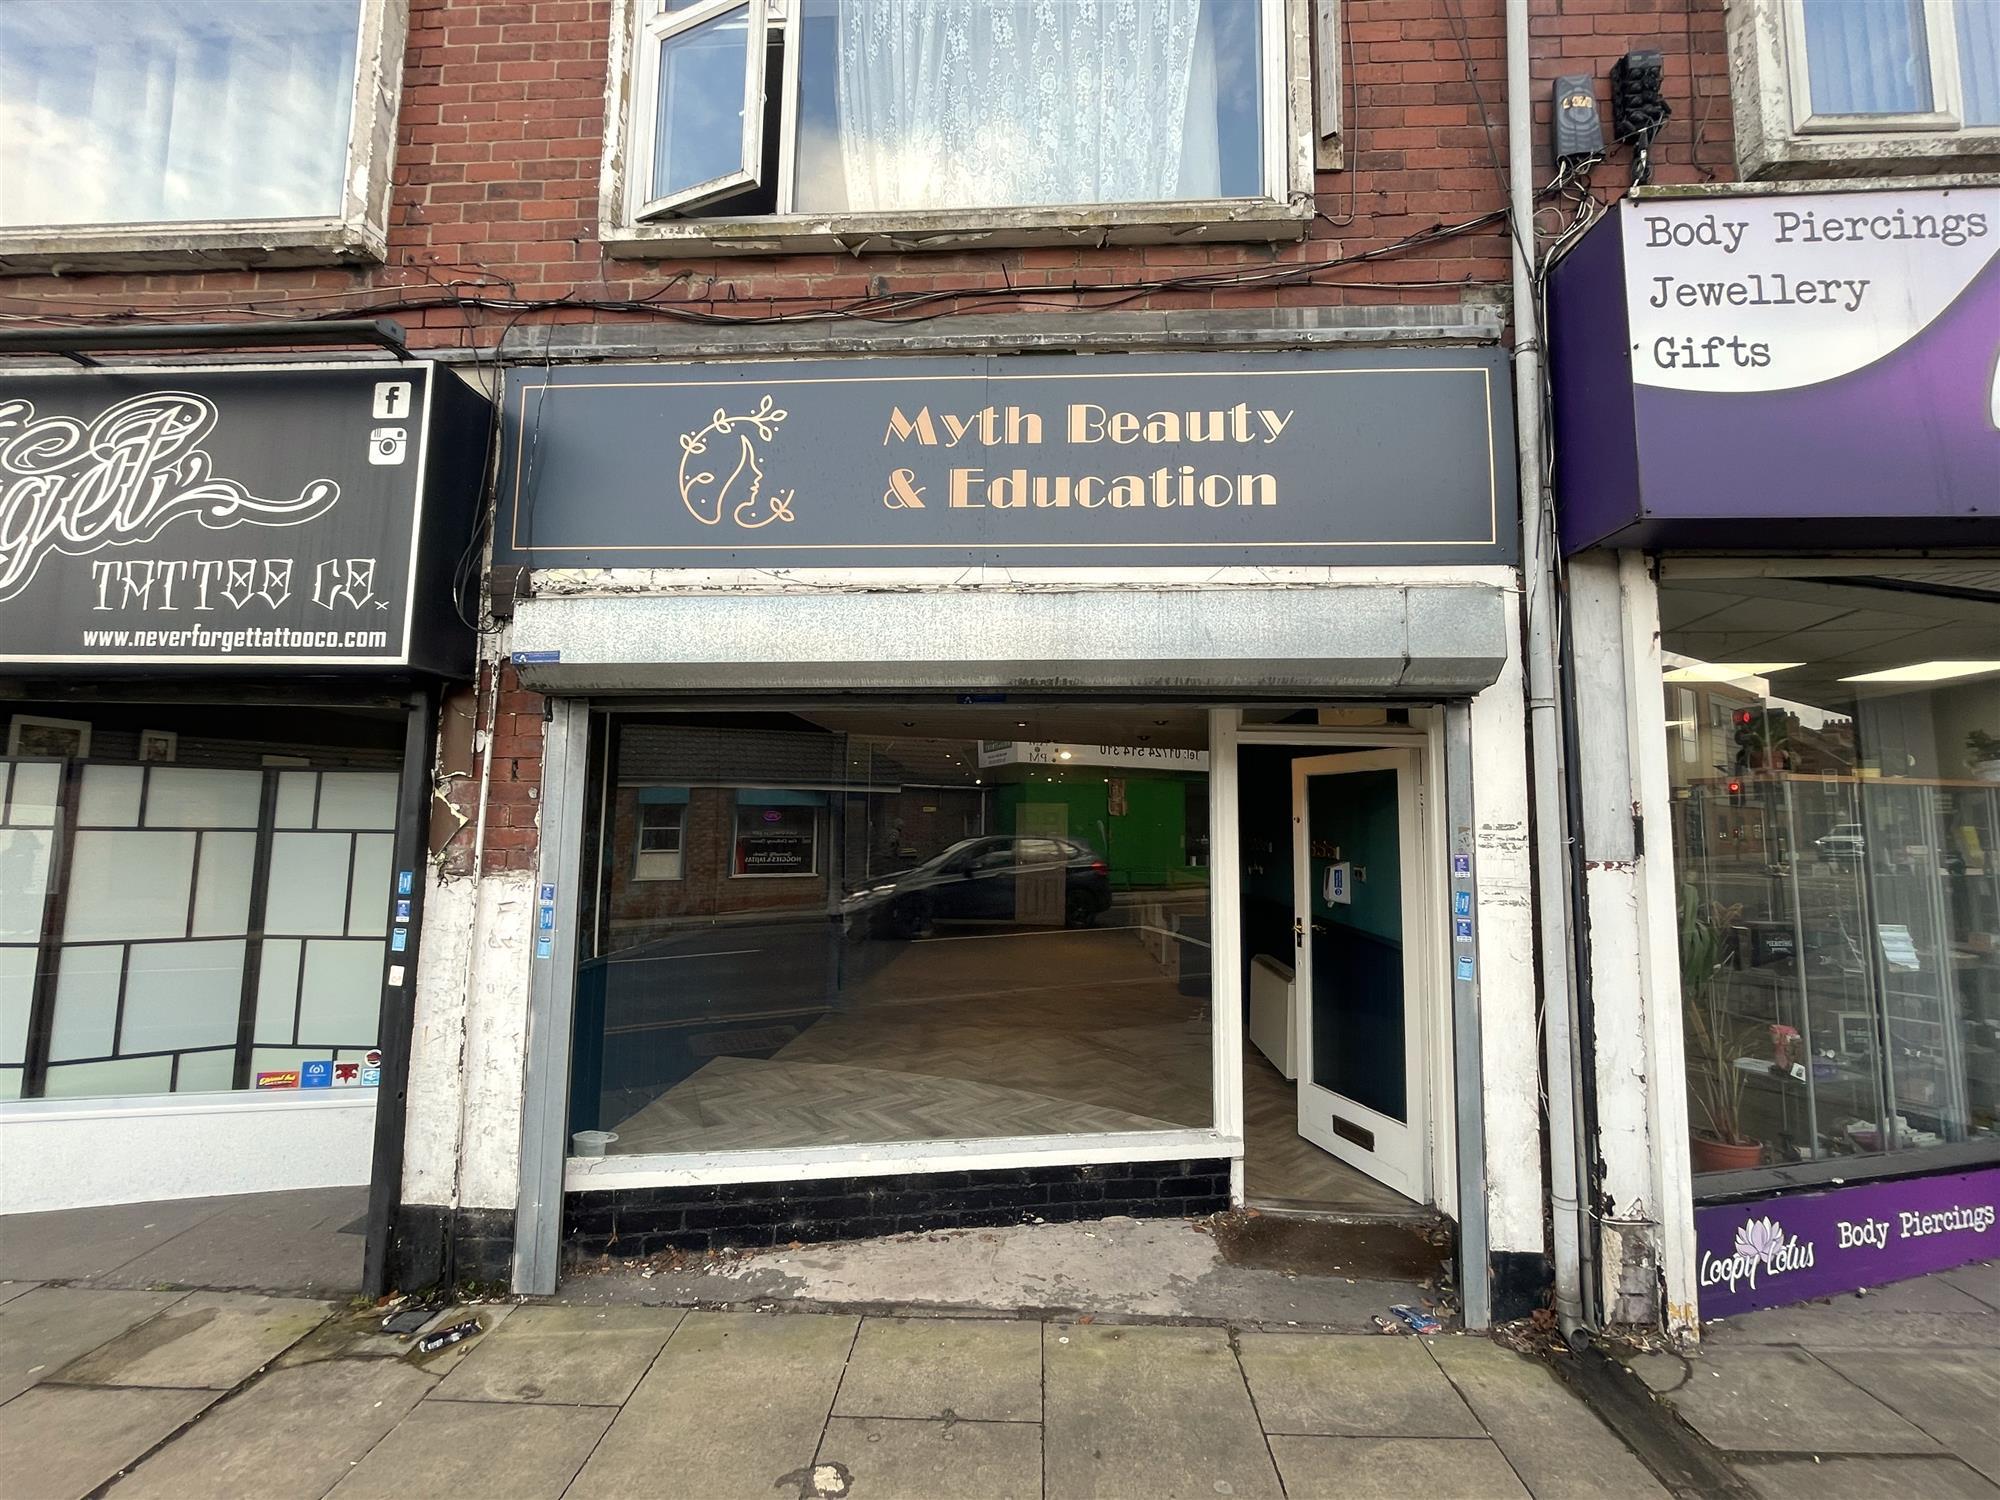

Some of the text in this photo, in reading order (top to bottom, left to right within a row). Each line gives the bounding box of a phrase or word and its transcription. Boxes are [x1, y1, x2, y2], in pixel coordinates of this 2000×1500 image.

[1644, 208, 1989, 254] Body Piercings
[1649, 273, 1871, 312] Jewellery
[1653, 334, 1772, 369] Gifts
[883, 402, 1294, 447] Myth Beauty
[883, 465, 1278, 510] & Education
[92, 557, 390, 612] TATTOO CO.
[82, 622, 387, 653] www.neverforgettattooco.com
[1837, 1205, 1995, 1249] Body Piercings
[1700, 1234, 1815, 1293] Loopy Lotus
